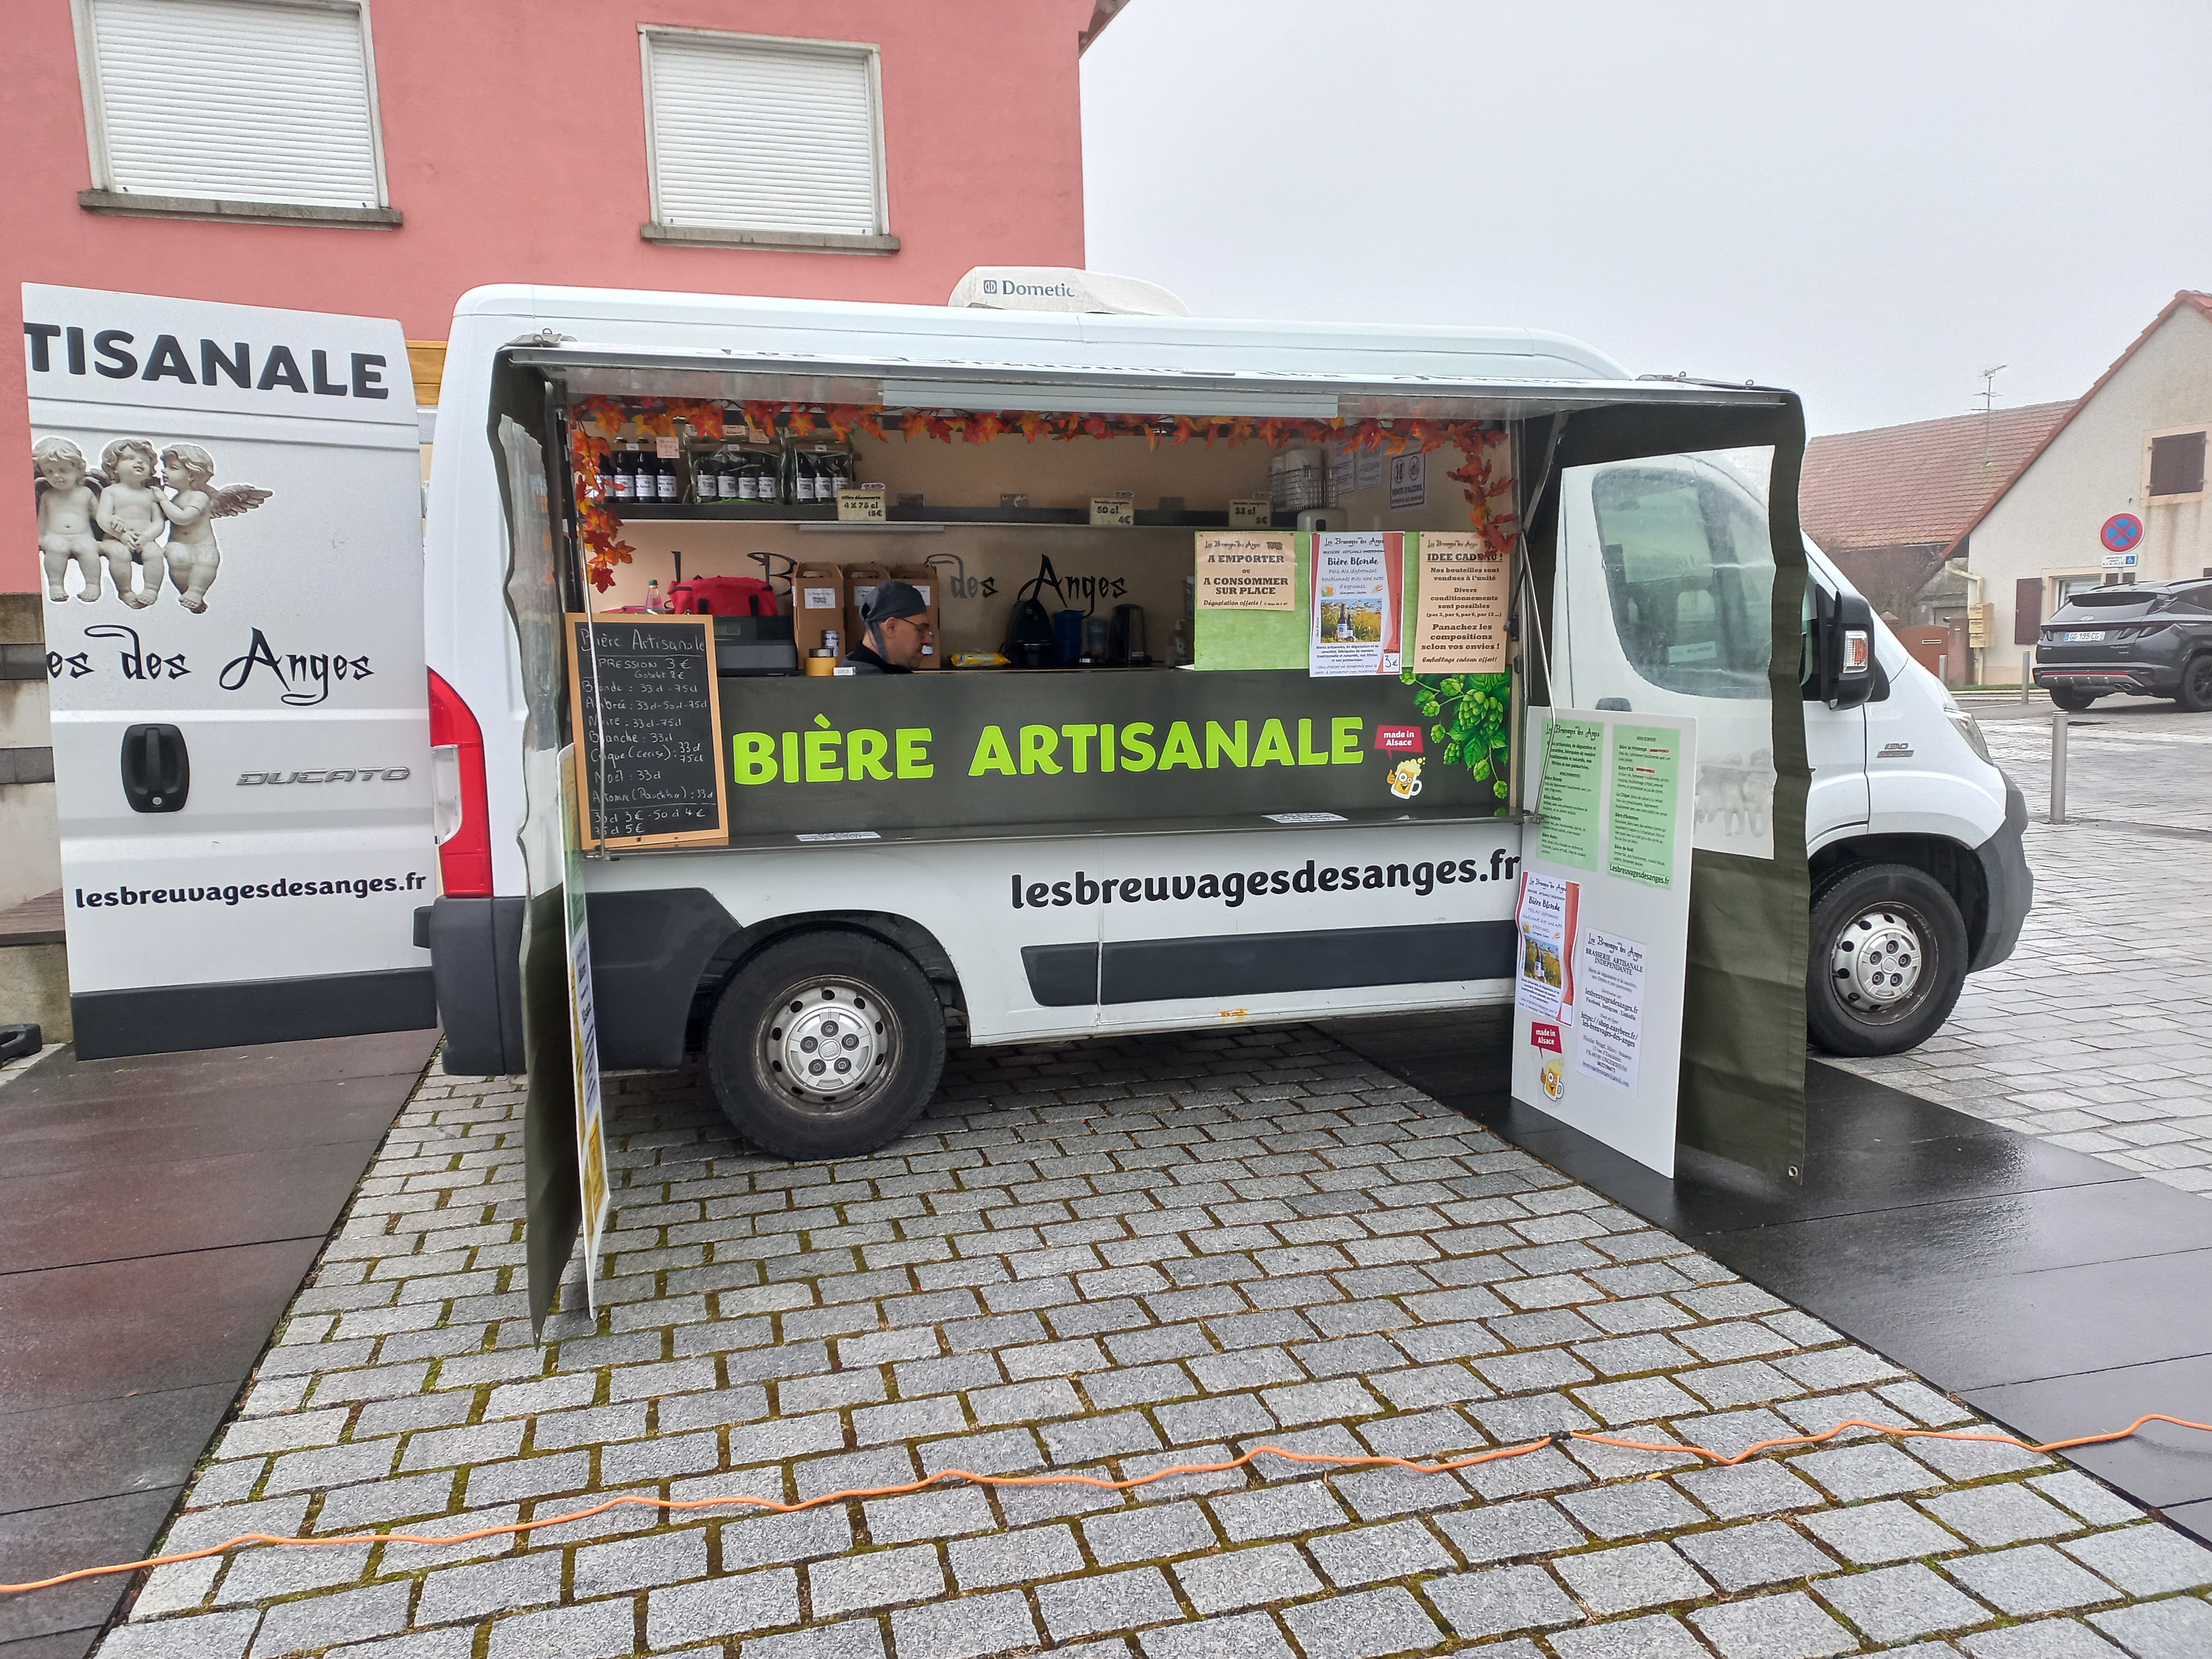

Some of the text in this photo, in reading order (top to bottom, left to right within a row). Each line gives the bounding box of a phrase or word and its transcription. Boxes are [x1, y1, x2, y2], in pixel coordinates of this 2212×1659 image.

[1002, 280, 1075, 297] Dometic
[23, 322, 388, 399] TISANALE
[1110, 505, 1119, 514] cl
[1248, 506, 1256, 515] cl
[1256, 516, 1268, 524] 3€
[1245, 541, 1260, 550] Anges
[1324, 538, 1332, 546] Les
[1327, 556, 1379, 565] Bière Blonde
[924, 553, 1128, 619] des Anges
[632, 629, 705, 651] Artisanale
[84, 625, 191, 679] des
[219, 627, 374, 706] Anges
[598, 658, 657, 669] PRESSION
[1384, 655, 1398, 667] 3€
[582, 680, 622, 693] Bonde
[589, 713, 620, 727] Nire
[589, 730, 639, 743] Banche
[733, 713, 1364, 785] BIÈRE ARTISANALE
[236, 766, 410, 785] DUCATO
[1011, 848, 1521, 910] lesbreuvagesdesanges.fr
[1610, 863, 1670, 885] Lesbreuvagesdesanges.fr
[75, 872, 427, 909] lesbreuvagesdesanges.fr
[1528, 896, 1560, 912] Bière Blonde
[1585, 947, 1643, 973] BRASSERIE ARTISANALE
[1594, 957, 1633, 976] INDEPENDANTE
[1538, 1037, 1555, 1045] Alsace
